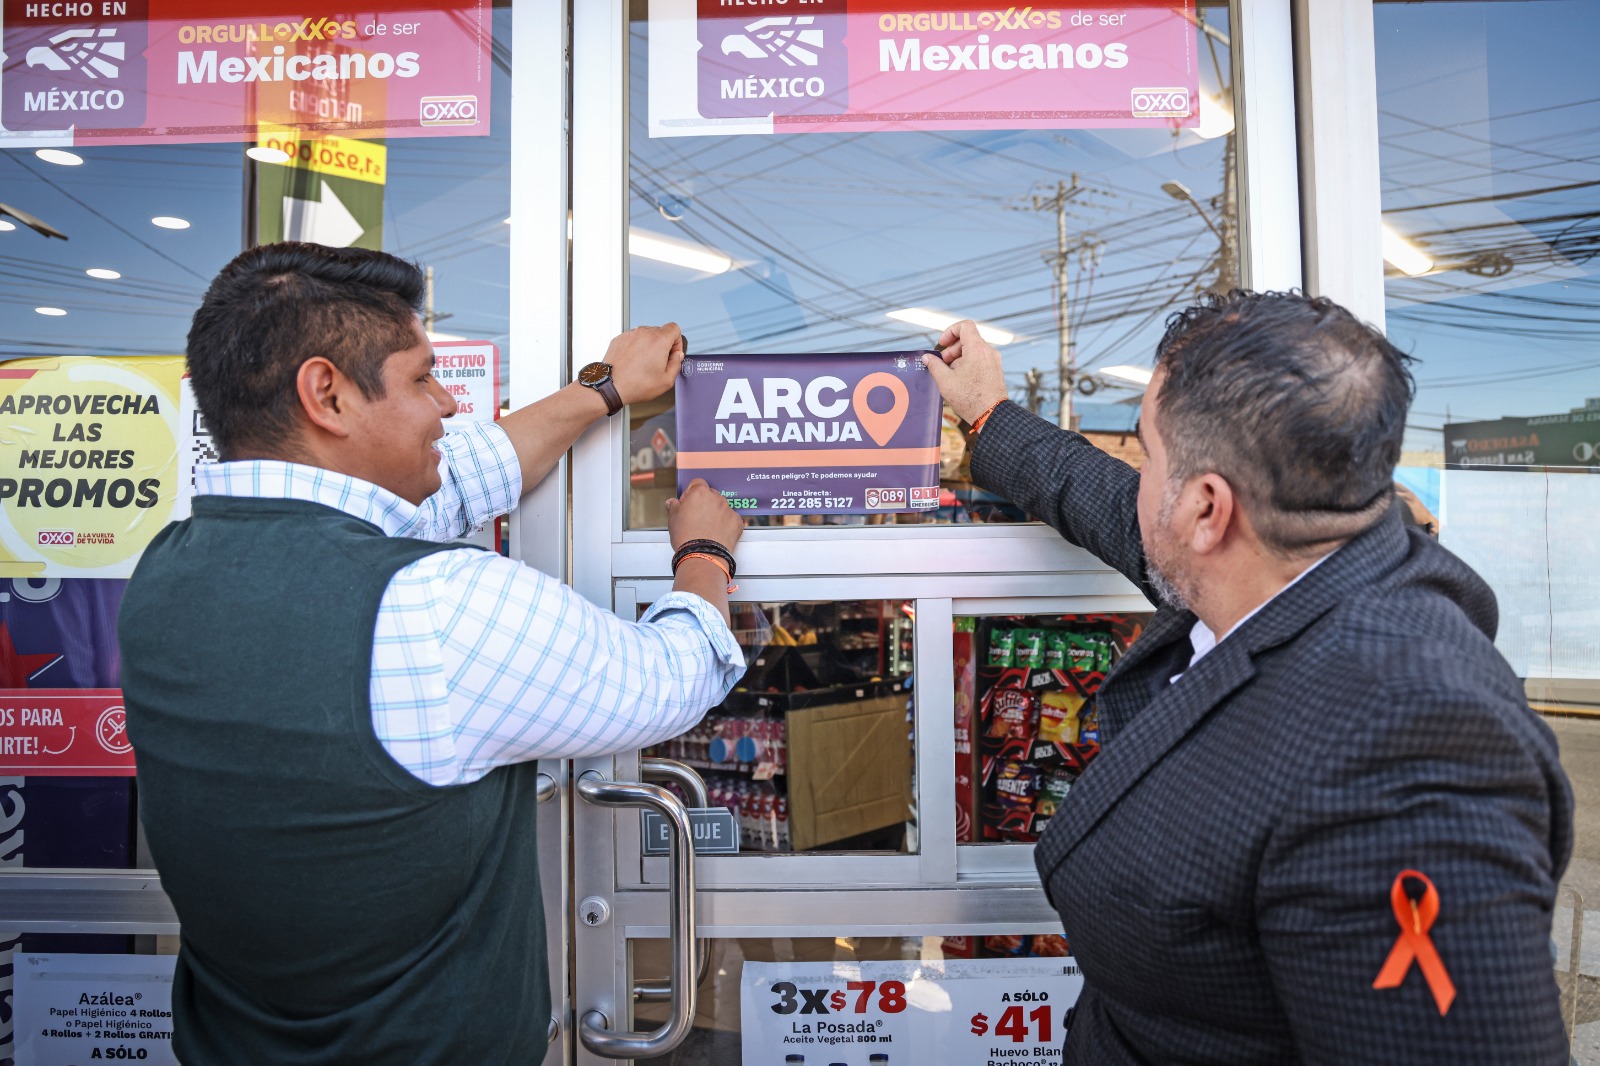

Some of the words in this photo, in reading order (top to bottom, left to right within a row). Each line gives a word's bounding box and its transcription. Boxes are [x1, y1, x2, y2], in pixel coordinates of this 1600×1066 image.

[26, 3, 93, 17] HECHO
[102, 2, 126, 16] EN
[878, 7, 1061, 32] ORGULLOXXOS
[1070, 10, 1092, 26] de
[1099, 12, 1126, 26] ser
[178, 18, 356, 44] ORGULLOXXOS
[364, 20, 387, 36] de
[393, 20, 420, 36] ser
[878, 34, 1129, 72] Mexicanos
[177, 46, 420, 84] Mexicanos
[720, 74, 824, 99] MÉXICO
[24, 87, 124, 112] MÉXICO
[1133, 92, 1188, 114] OXXO
[422, 100, 476, 121] OXXO
[432, 354, 486, 368] FECTIVO
[443, 370, 454, 378] DE
[456, 367, 486, 378] DÉBITO
[0, 394, 160, 415] APROVECHA
[456, 400, 474, 414] ÍAS
[52, 422, 102, 442] LAS
[715, 421, 862, 444] NARANJA
[18, 450, 135, 469] MEJORES
[746, 473, 770, 481] ¿Estás
[820, 472, 852, 480] podemos
[0, 478, 161, 508] PROMOS
[882, 490, 904, 502] 089
[771, 498, 795, 509] 222
[798, 498, 822, 508] 285
[825, 497, 853, 508] 5127
[39, 532, 74, 544] OXXO
[22, 708, 64, 726] PARA
[660, 823, 721, 840] EUJE
[1001, 992, 1011, 1002] A
[1013, 989, 1049, 1002] SÓLO
[50, 1008, 78, 1018] Papel
[80, 1008, 127, 1018] Higiénico
[140, 1010, 172, 1018] Rollos
[74, 1020, 102, 1029] Papel
[106, 1020, 152, 1030] Higiénico
[792, 1021, 811, 1034] La
[50, 1029, 82, 1038] Rollos
[104, 1030, 136, 1039] Rollos
[817, 1035, 855, 1045] Vegetal
[879, 1035, 892, 1043] ml
[91, 1048, 102, 1059] A
[106, 1045, 148, 1060] SÓLO
[990, 1048, 1029, 1057] Huevo
[1034, 1047, 1060, 1057] Blan
